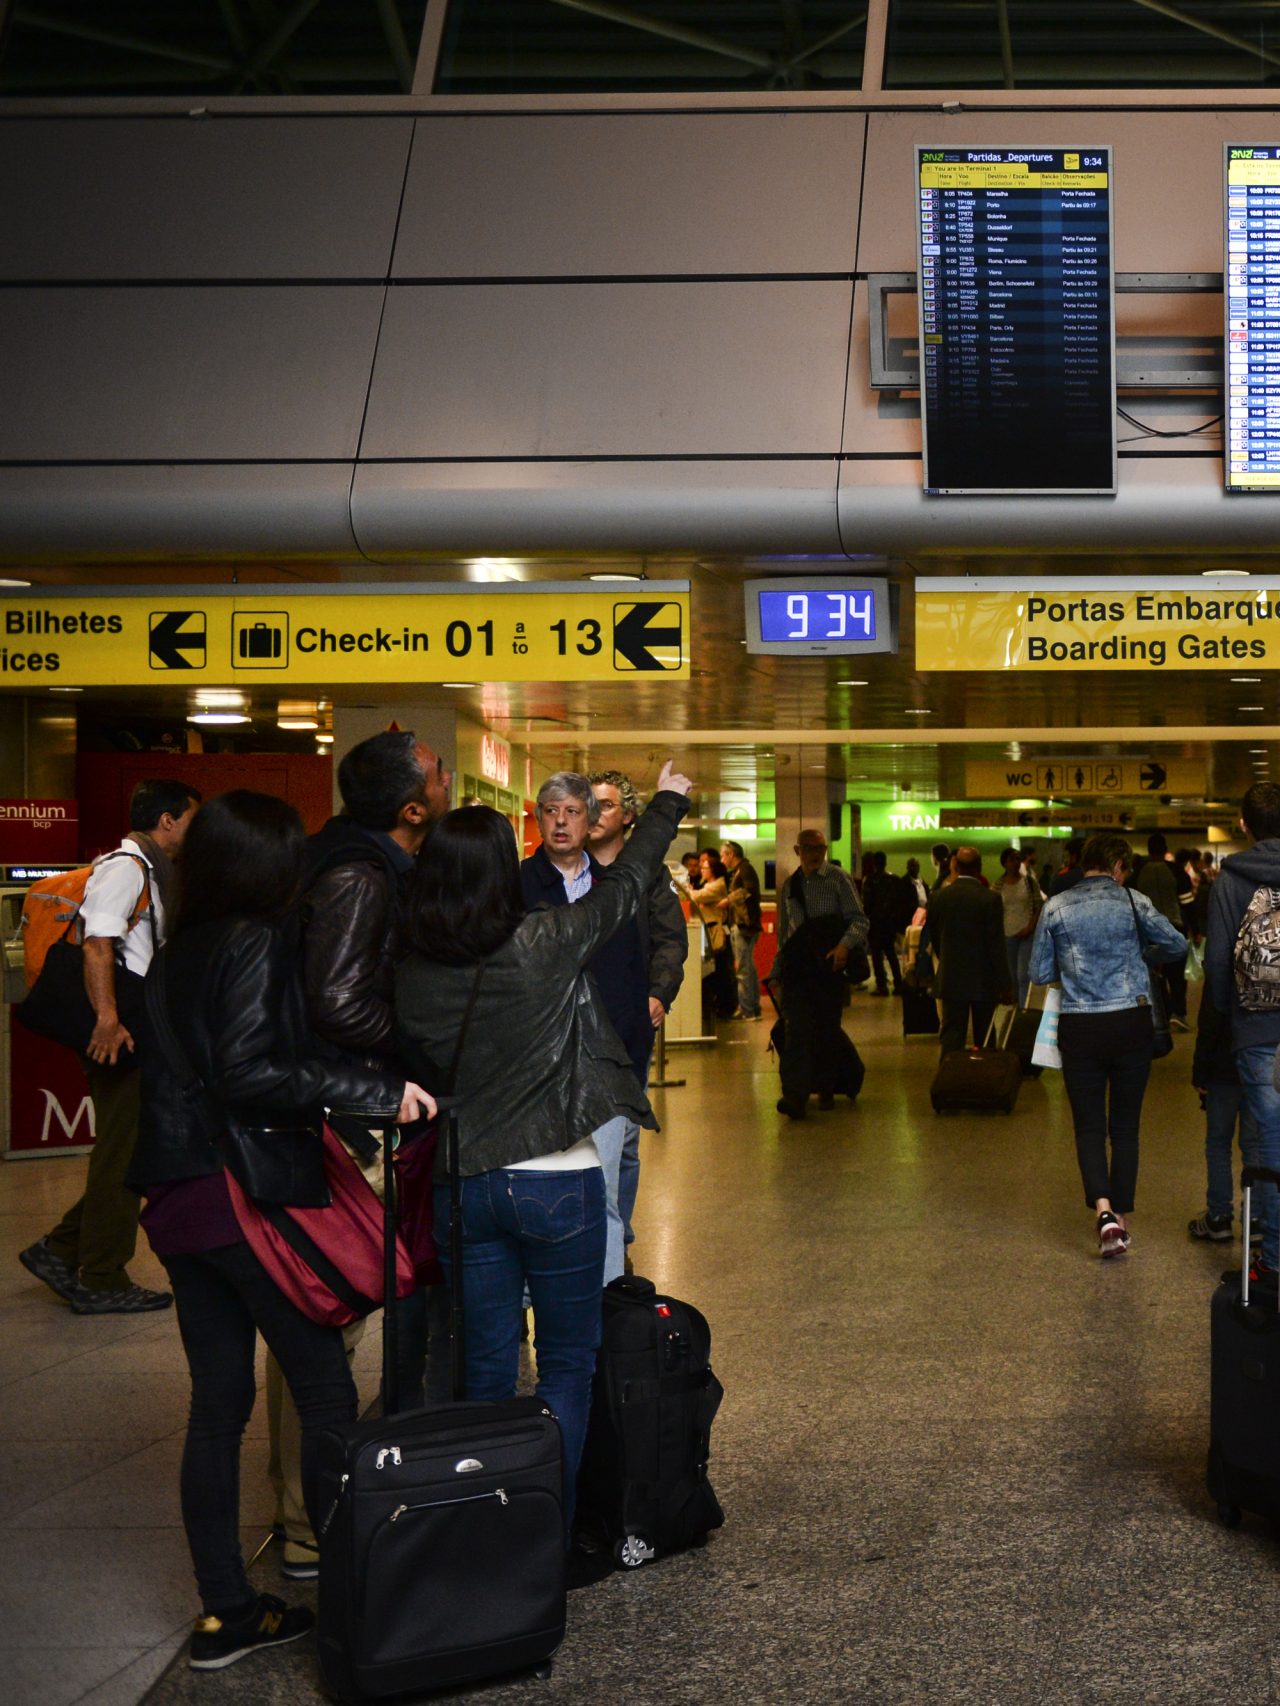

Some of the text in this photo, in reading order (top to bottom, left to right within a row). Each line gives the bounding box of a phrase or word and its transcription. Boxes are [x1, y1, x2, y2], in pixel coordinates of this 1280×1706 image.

[968, 153, 1001, 162] Partidas
[1003, 153, 1053, 163] _Departures
[1084, 157, 1102, 166] 9:34
[6, 610, 123, 634] Bilhetes
[787, 594, 871, 638] 9 34
[1027, 597, 1125, 622] Portas
[295, 619, 602, 657] Check-in 01 a to 13
[1027, 635, 1267, 666] Boarding Gates
[0, 647, 60, 672] ices
[1006, 773, 1033, 787] WC
[33, 819, 52, 830] bcp
[37, 1088, 97, 1142] M
